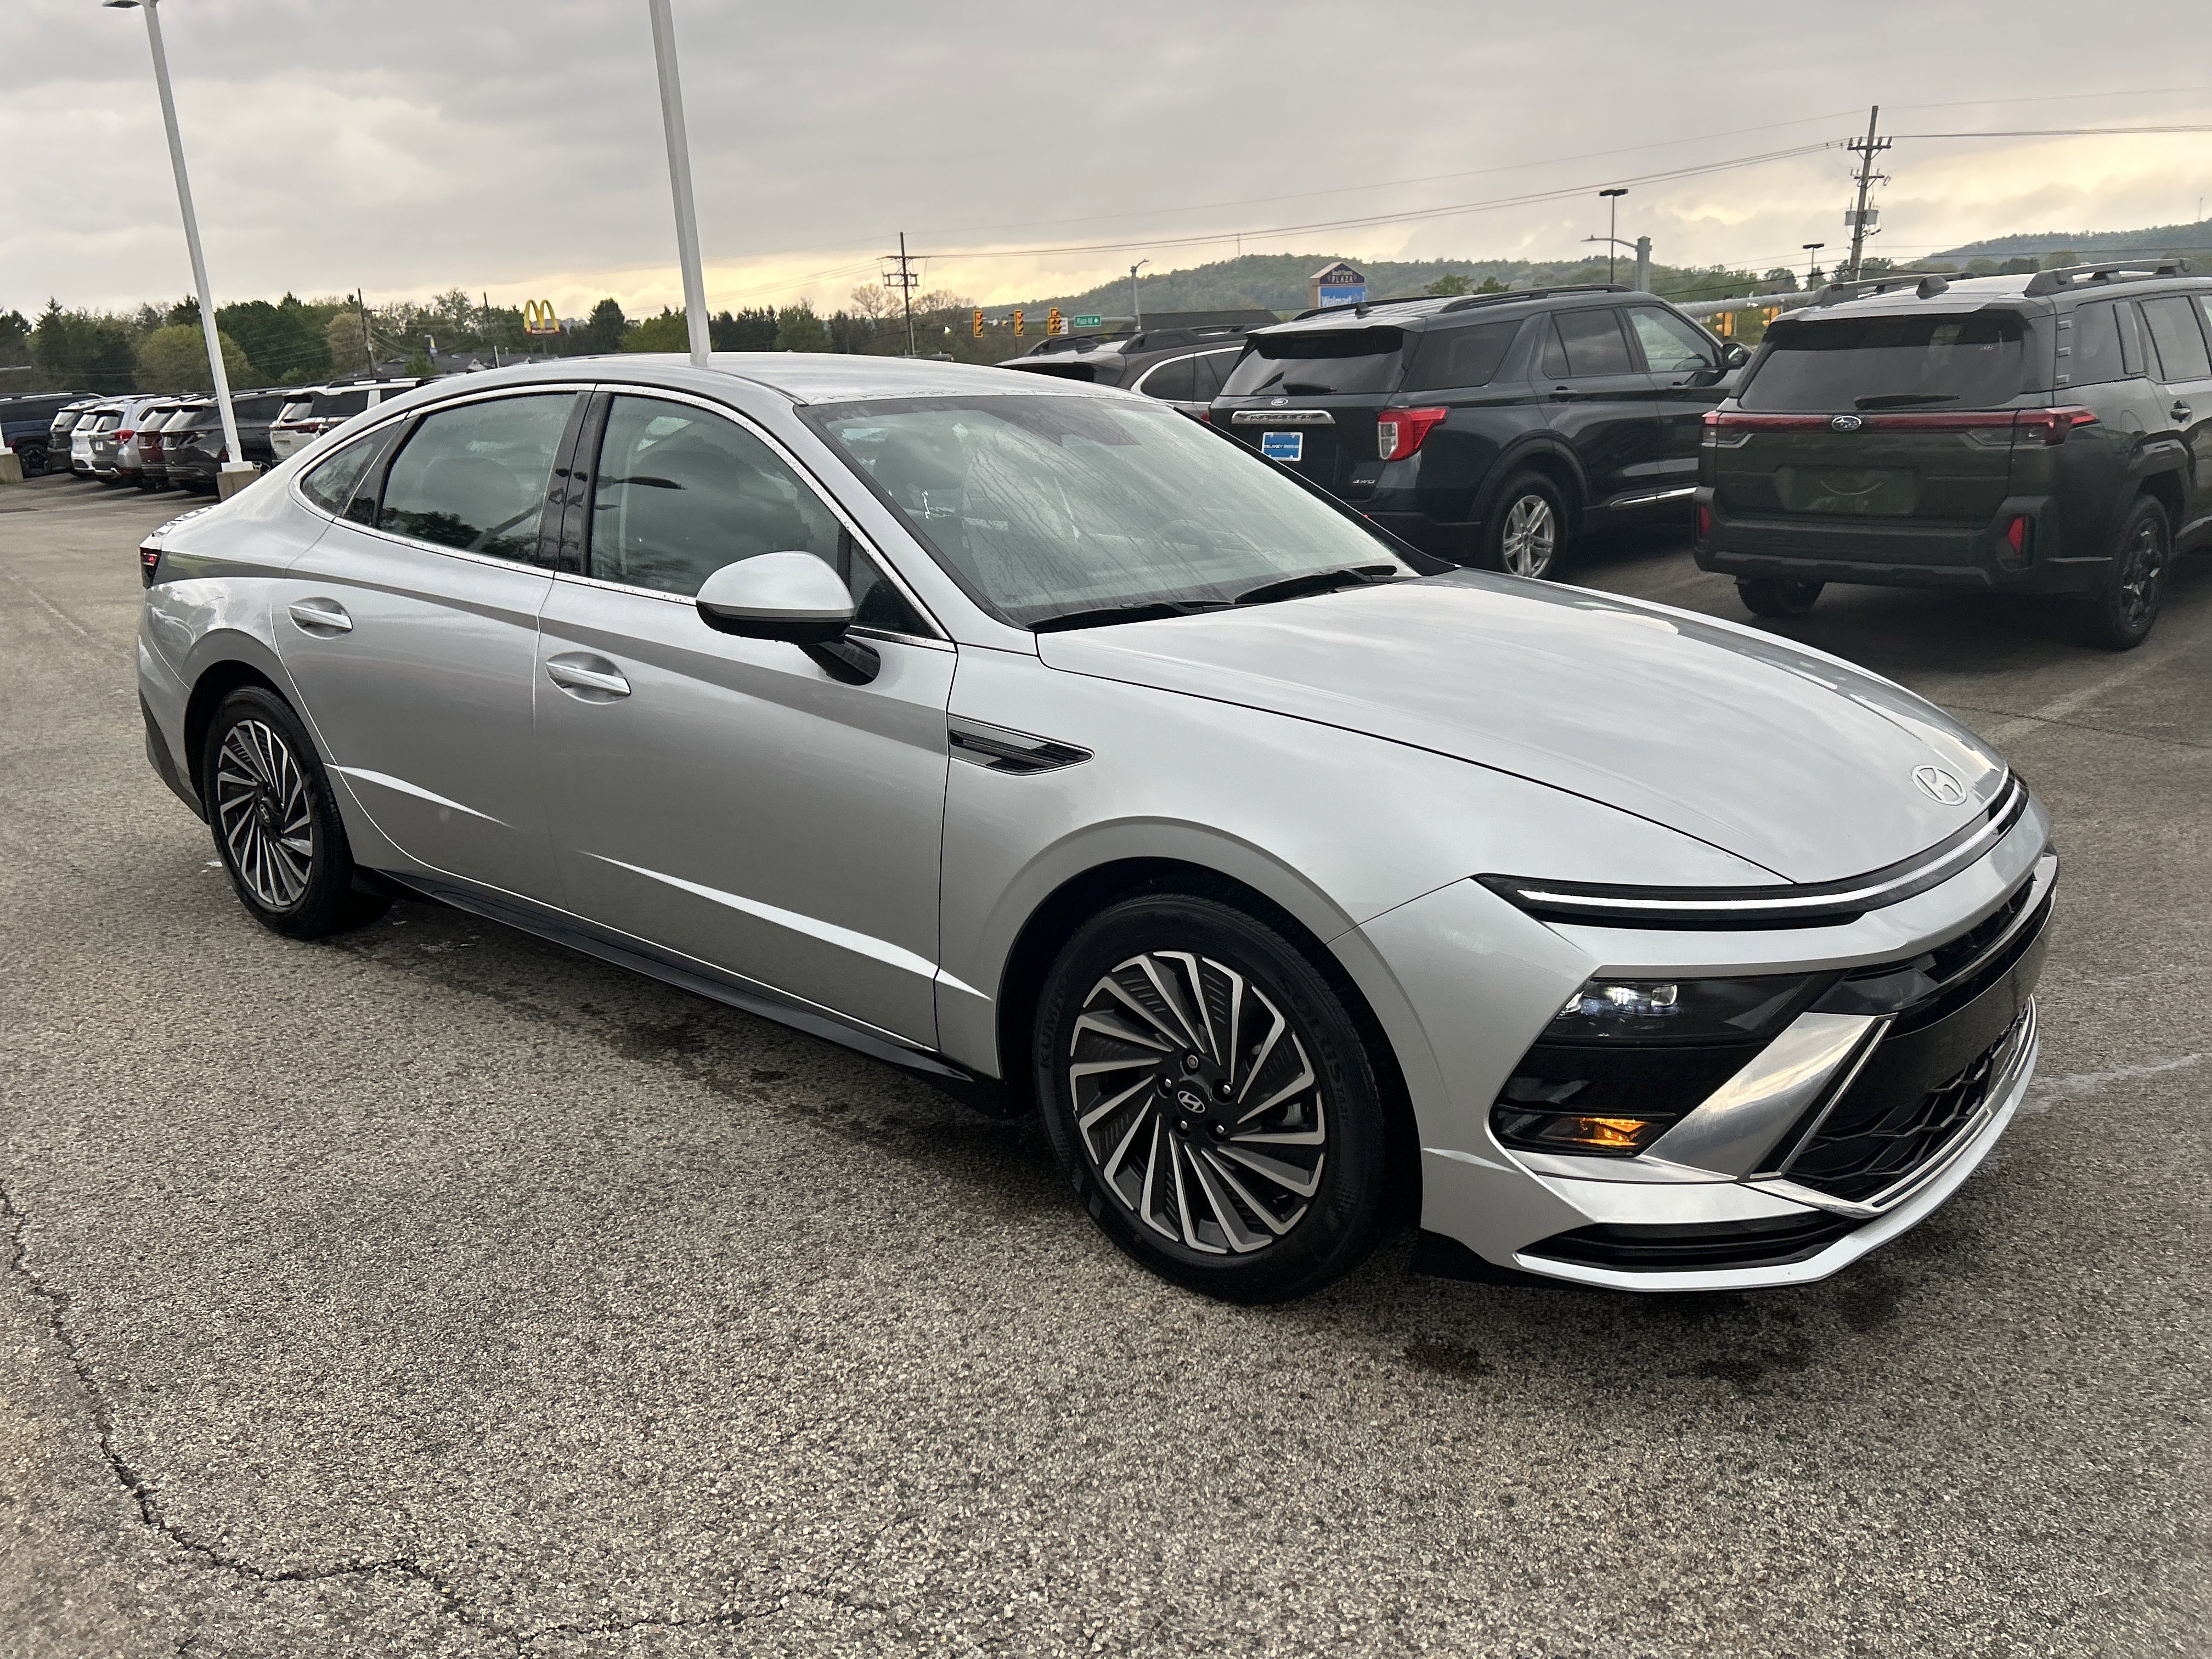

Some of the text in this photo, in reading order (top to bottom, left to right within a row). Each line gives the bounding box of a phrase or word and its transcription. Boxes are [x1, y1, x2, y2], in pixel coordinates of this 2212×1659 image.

[1322, 295, 1352, 307] Walmart
[1040, 974, 1068, 1070] KUMHO
[1276, 975, 1346, 1084] SOLUS
